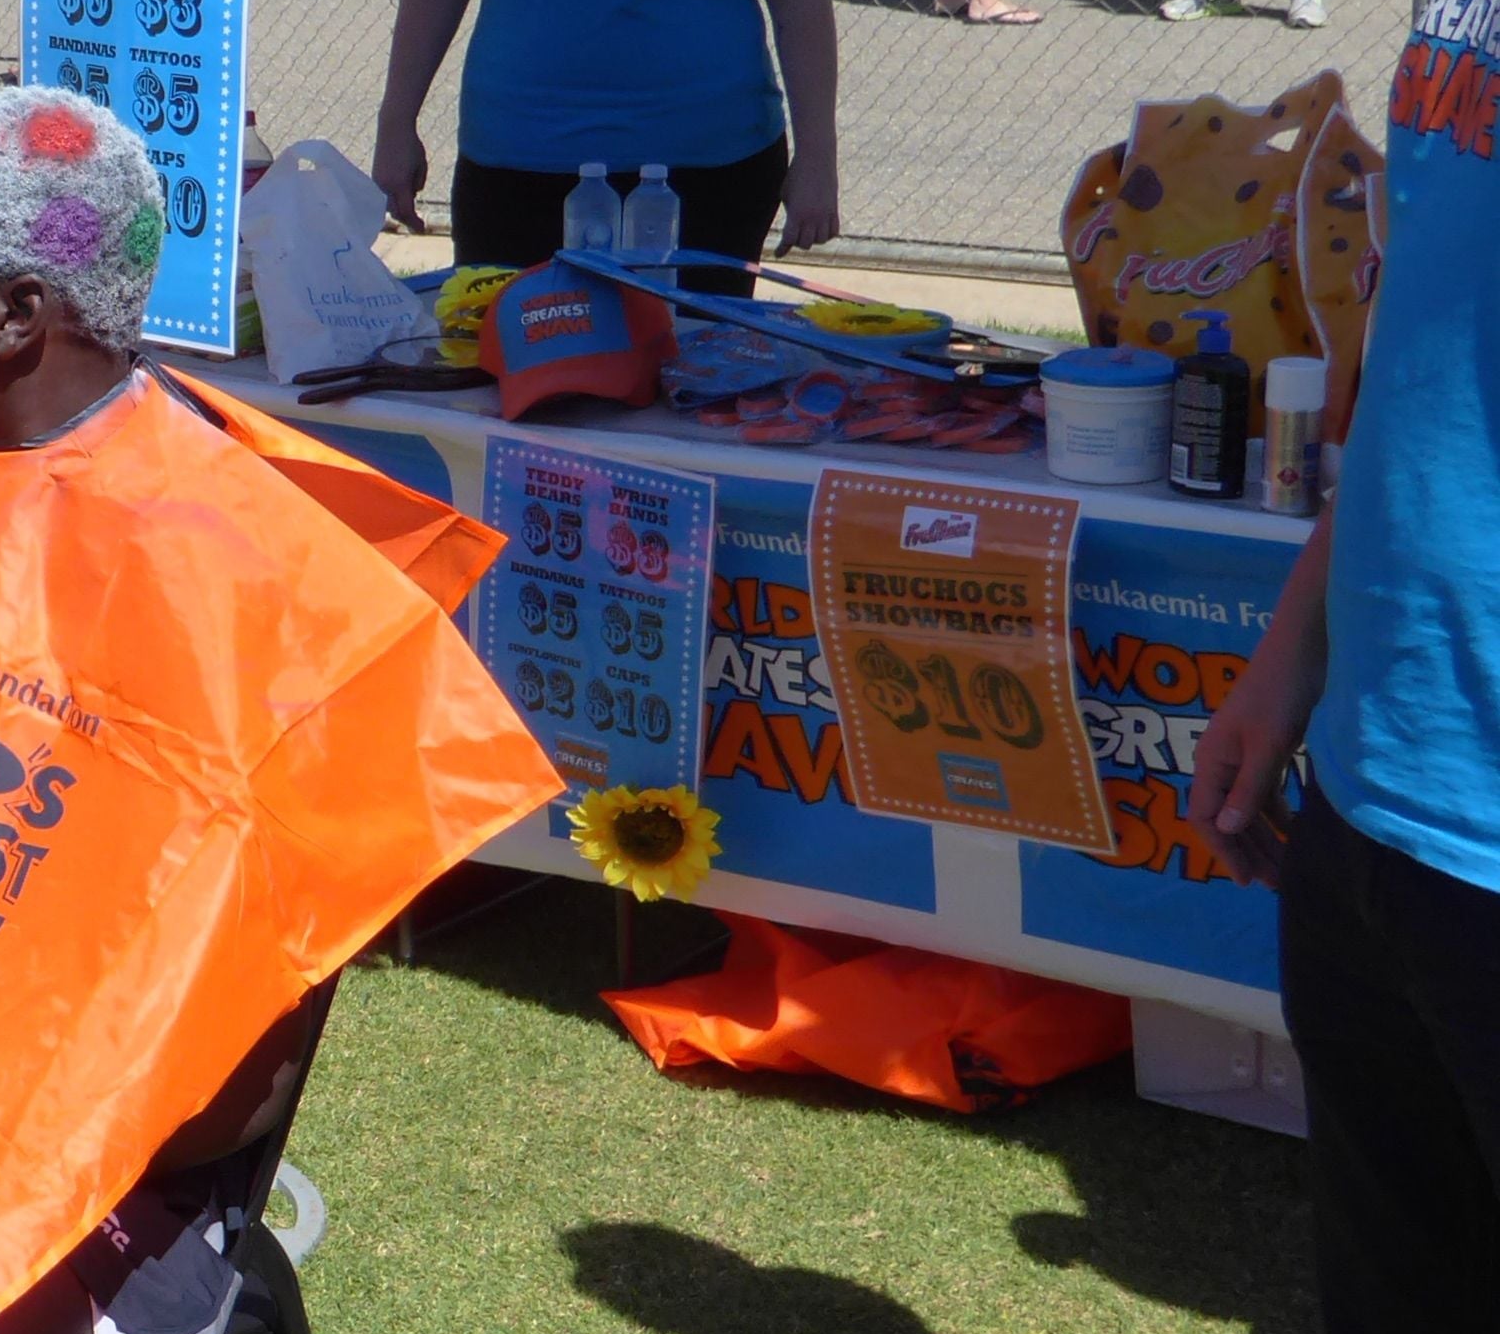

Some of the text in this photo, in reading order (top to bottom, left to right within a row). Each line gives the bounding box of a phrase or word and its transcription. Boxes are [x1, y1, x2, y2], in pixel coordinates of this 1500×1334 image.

[49, 36, 116, 59] BANDANAS
[129, 47, 202, 68] TATTOOS
[132, 67, 200, 136] $5
[146, 148, 186, 169] APS
[520, 303, 591, 326] GREATEST
[524, 483, 583, 508] BEARS
[525, 466, 585, 491] TEDDY
[611, 485, 670, 509] WRIST
[520, 502, 583, 561] $5
[609, 502, 669, 527] BANDS
[605, 520, 670, 582] $3
[716, 523, 809, 556] Found
[599, 583, 666, 609] TATTOOS
[842, 571, 1029, 608] FRUCHOCS
[1073, 579, 1228, 625] eukaemia
[517, 582, 579, 641] $5
[600, 599, 664, 661] $5
[845, 601, 1035, 638] SHOWBAGS
[515, 659, 575, 720] $2
[606, 666, 650, 687] CAPS
[705, 634, 837, 714] ATES
[584, 677, 672, 744] $10
[855, 639, 1044, 750] $10
